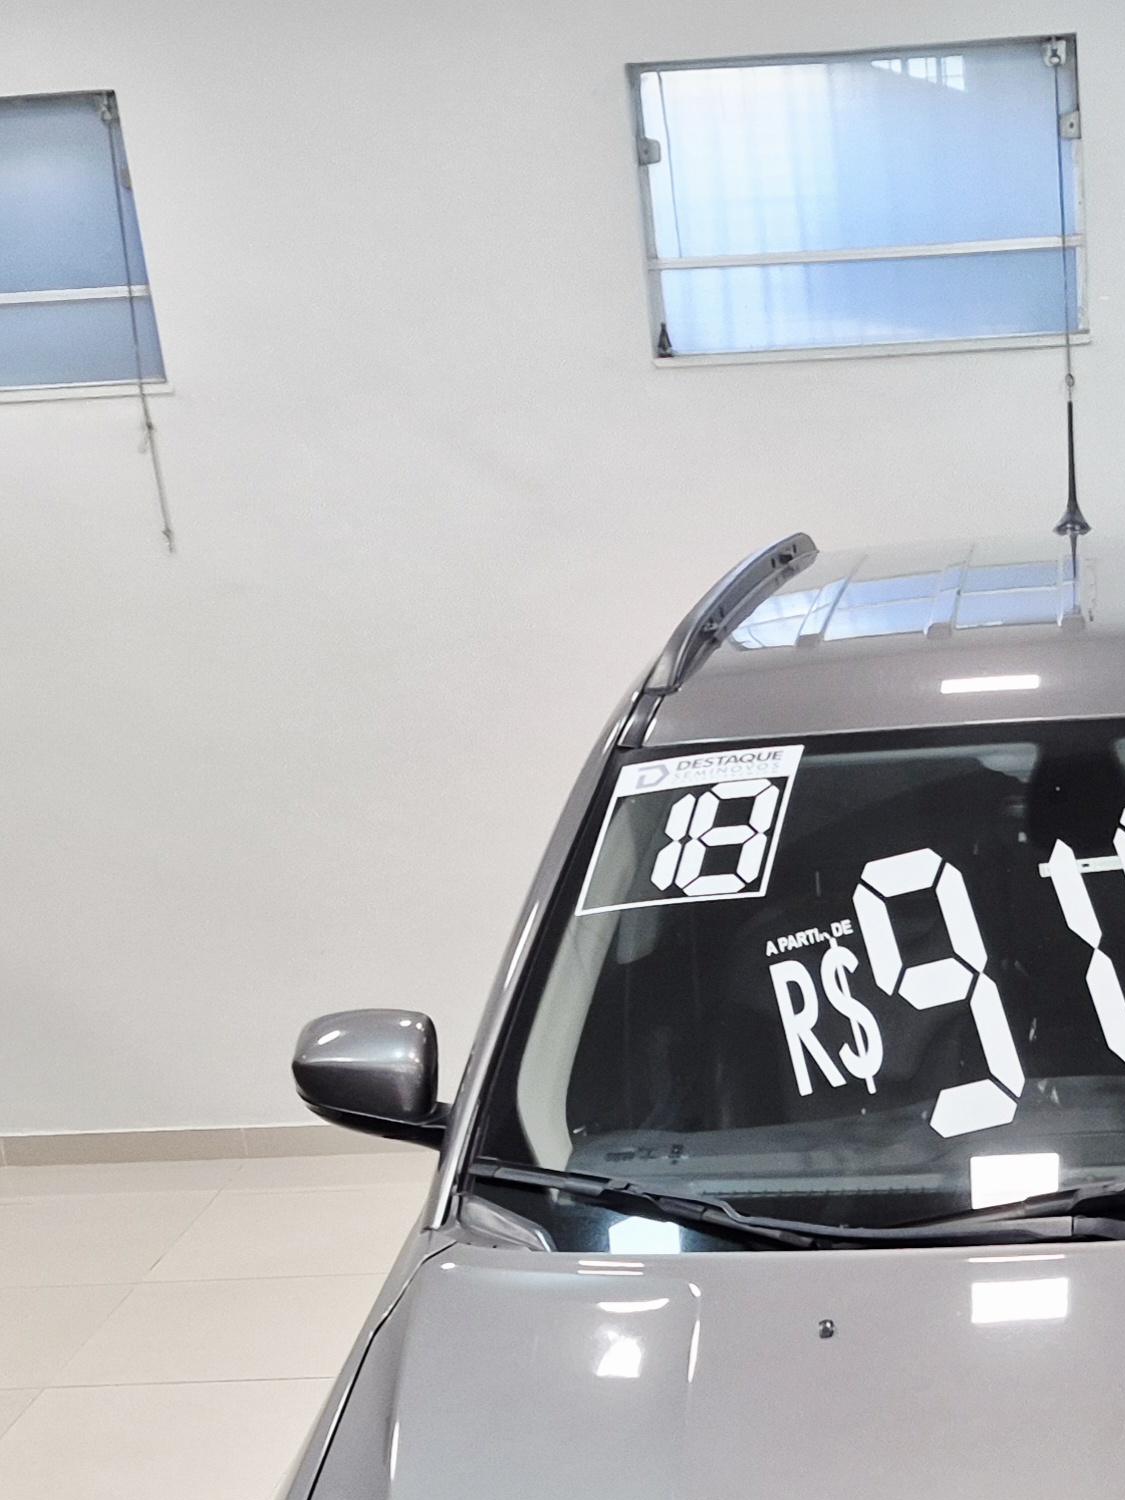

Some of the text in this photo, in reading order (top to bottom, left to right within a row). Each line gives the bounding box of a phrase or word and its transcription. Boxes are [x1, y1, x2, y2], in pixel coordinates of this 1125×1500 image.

[677, 750, 784, 771] DESTAQUE
[650, 778, 780, 897] 18
[765, 940, 779, 957] A
[830, 918, 854, 938] DE
[768, 937, 884, 1097] R$
